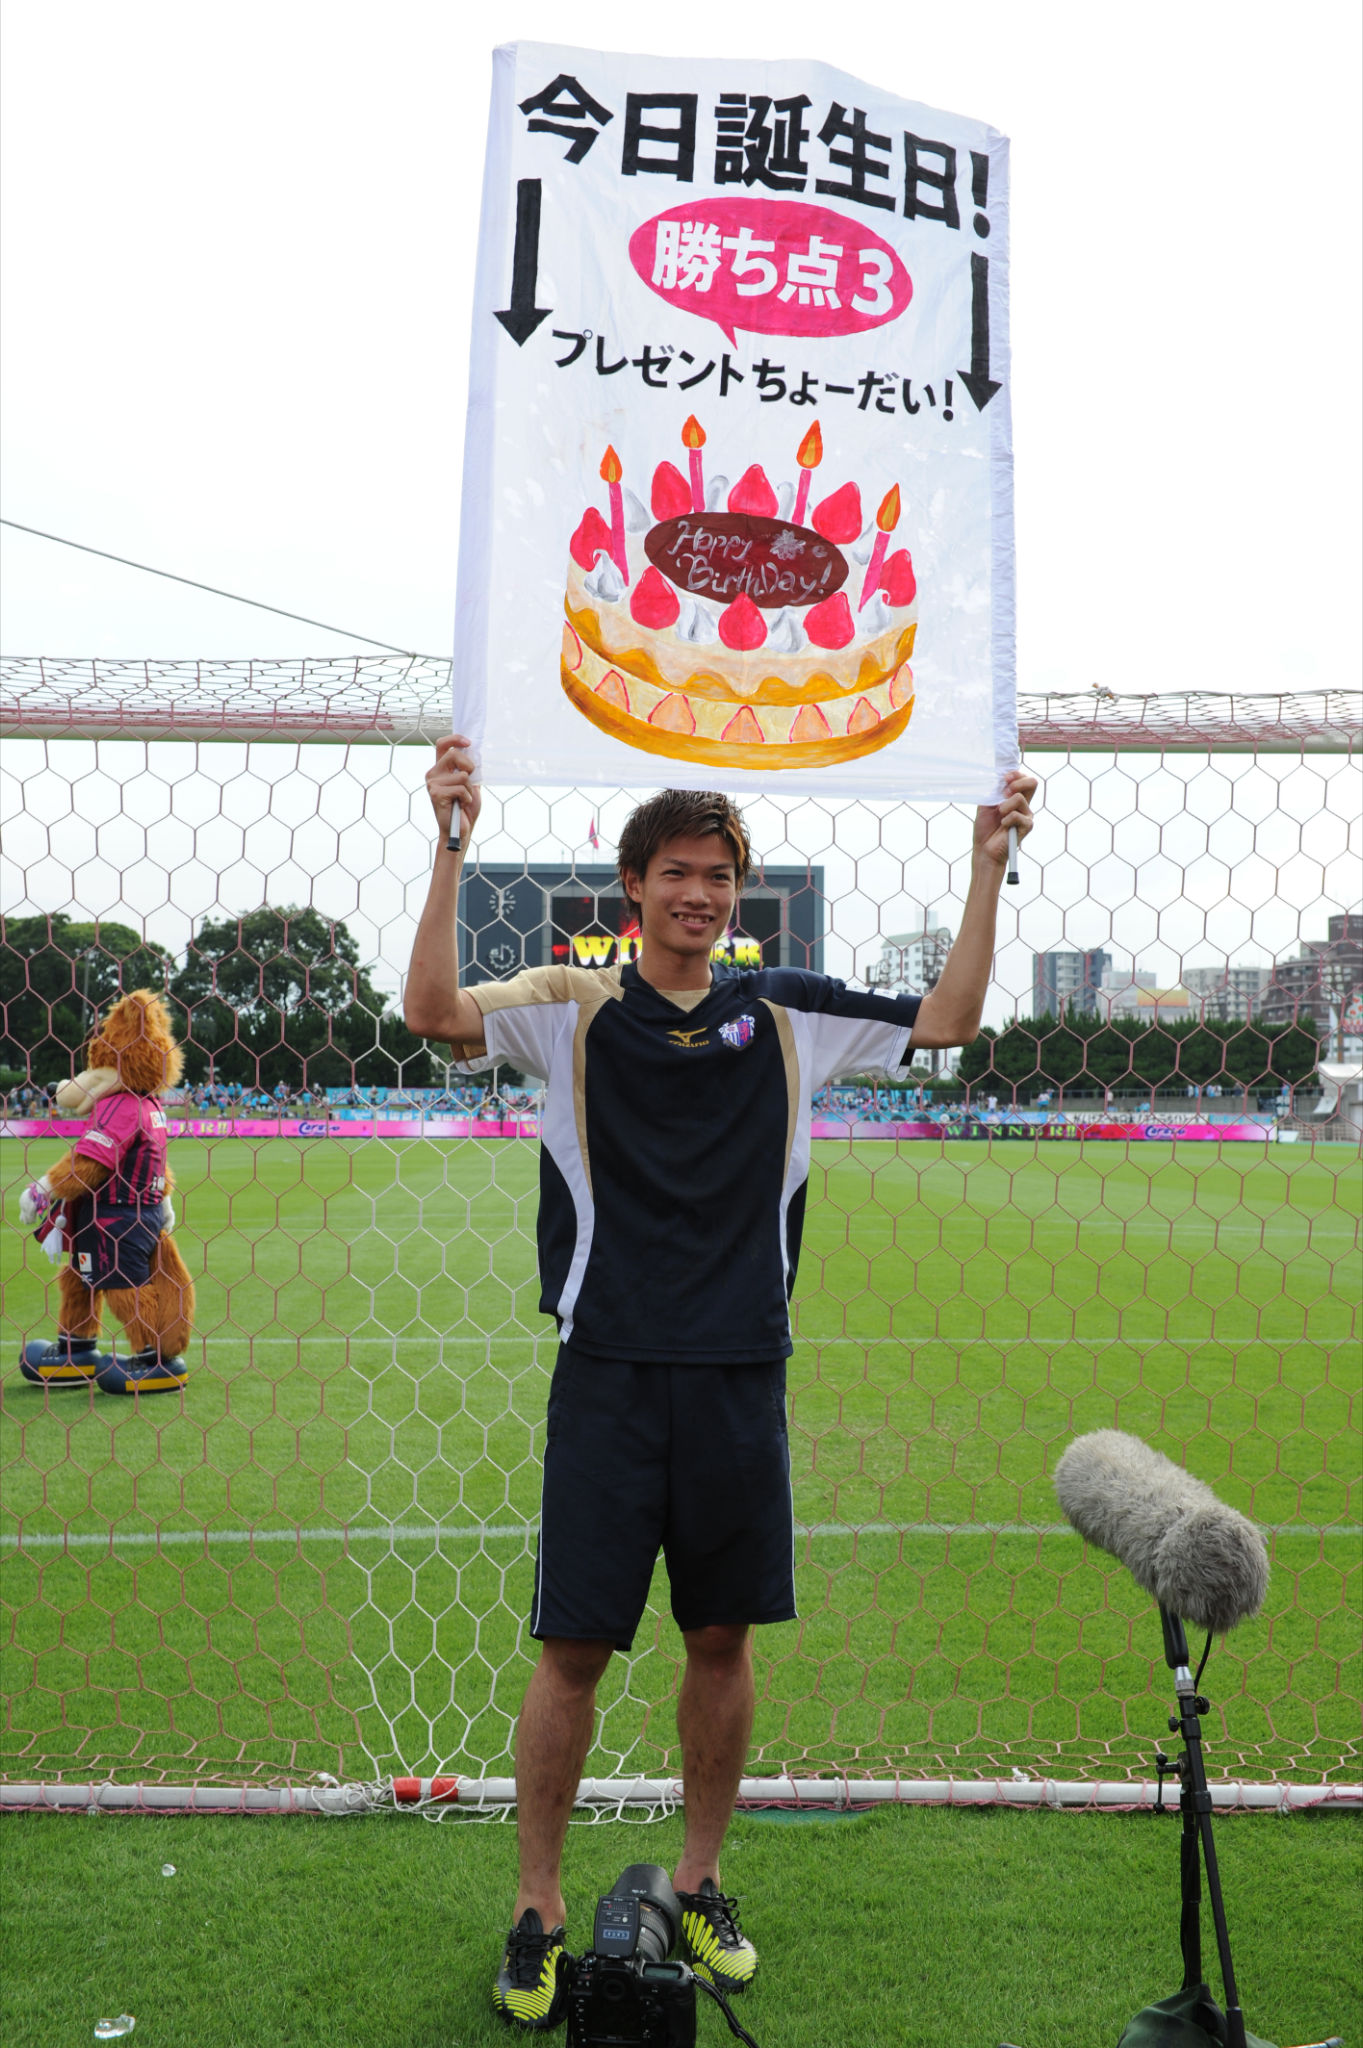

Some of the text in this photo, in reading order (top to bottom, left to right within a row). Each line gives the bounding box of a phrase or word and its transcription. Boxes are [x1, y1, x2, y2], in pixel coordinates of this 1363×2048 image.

[517, 73, 992, 239] 今日誕生日!
[651, 219, 895, 317] 勝ち点3
[552, 328, 954, 422] プレゼントちょーだい!
[667, 520, 753, 560] Happy
